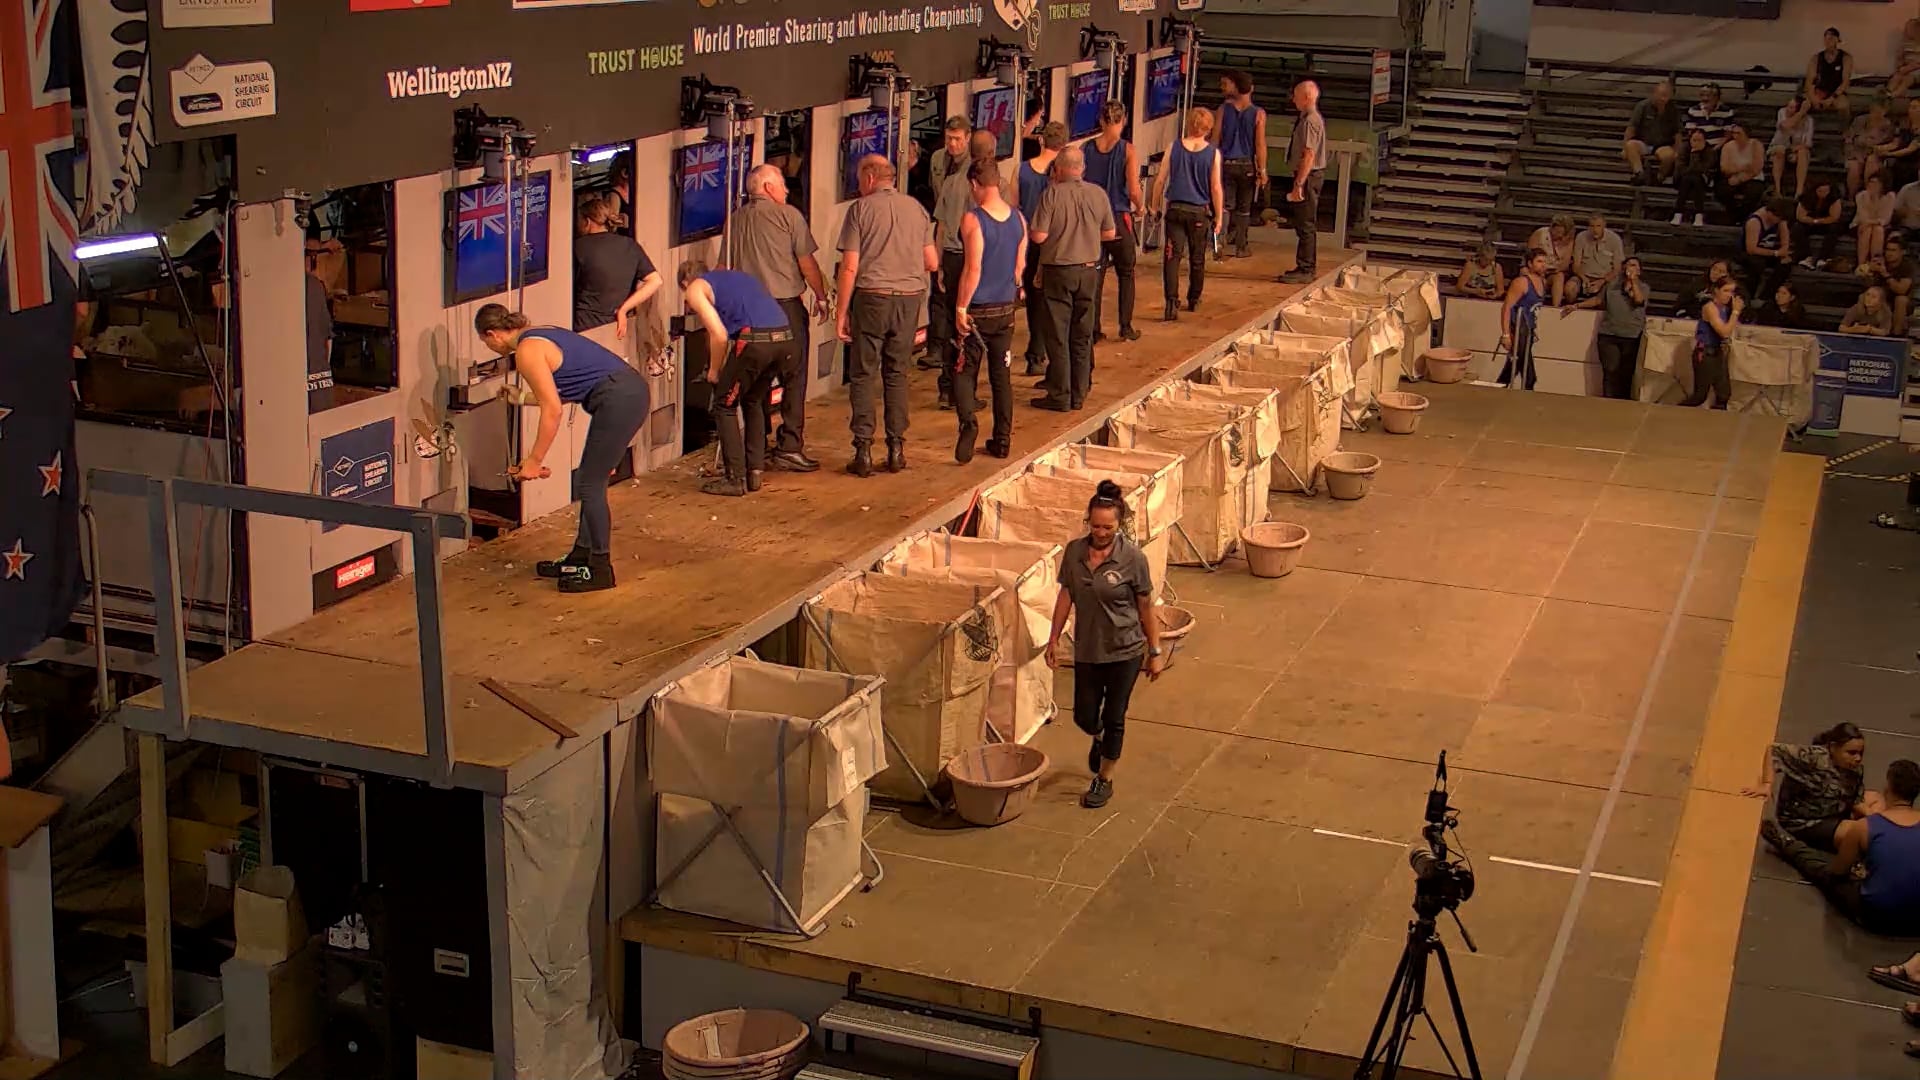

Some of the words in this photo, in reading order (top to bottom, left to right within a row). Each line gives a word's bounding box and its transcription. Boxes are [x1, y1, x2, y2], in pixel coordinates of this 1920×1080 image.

[694, 25, 730, 54] World
[736, 22, 780, 50] Premier
[785, 17, 834, 44] Shearing
[837, 13, 855, 38] and
[858, 8, 920, 36] Woolhandling
[924, 2, 983, 31] Championship
[588, 48, 635, 75] TRUST
[640, 44, 684, 70] HOUSE
[234, 71, 269, 84] NATIONAL
[387, 62, 513, 99] WellingtonNZ
[234, 84, 270, 97] SHEARING
[235, 97, 262, 109] CIRCUIT
[1849, 360, 1889, 369] NATIONAL
[1849, 367, 1889, 377] SHEARING
